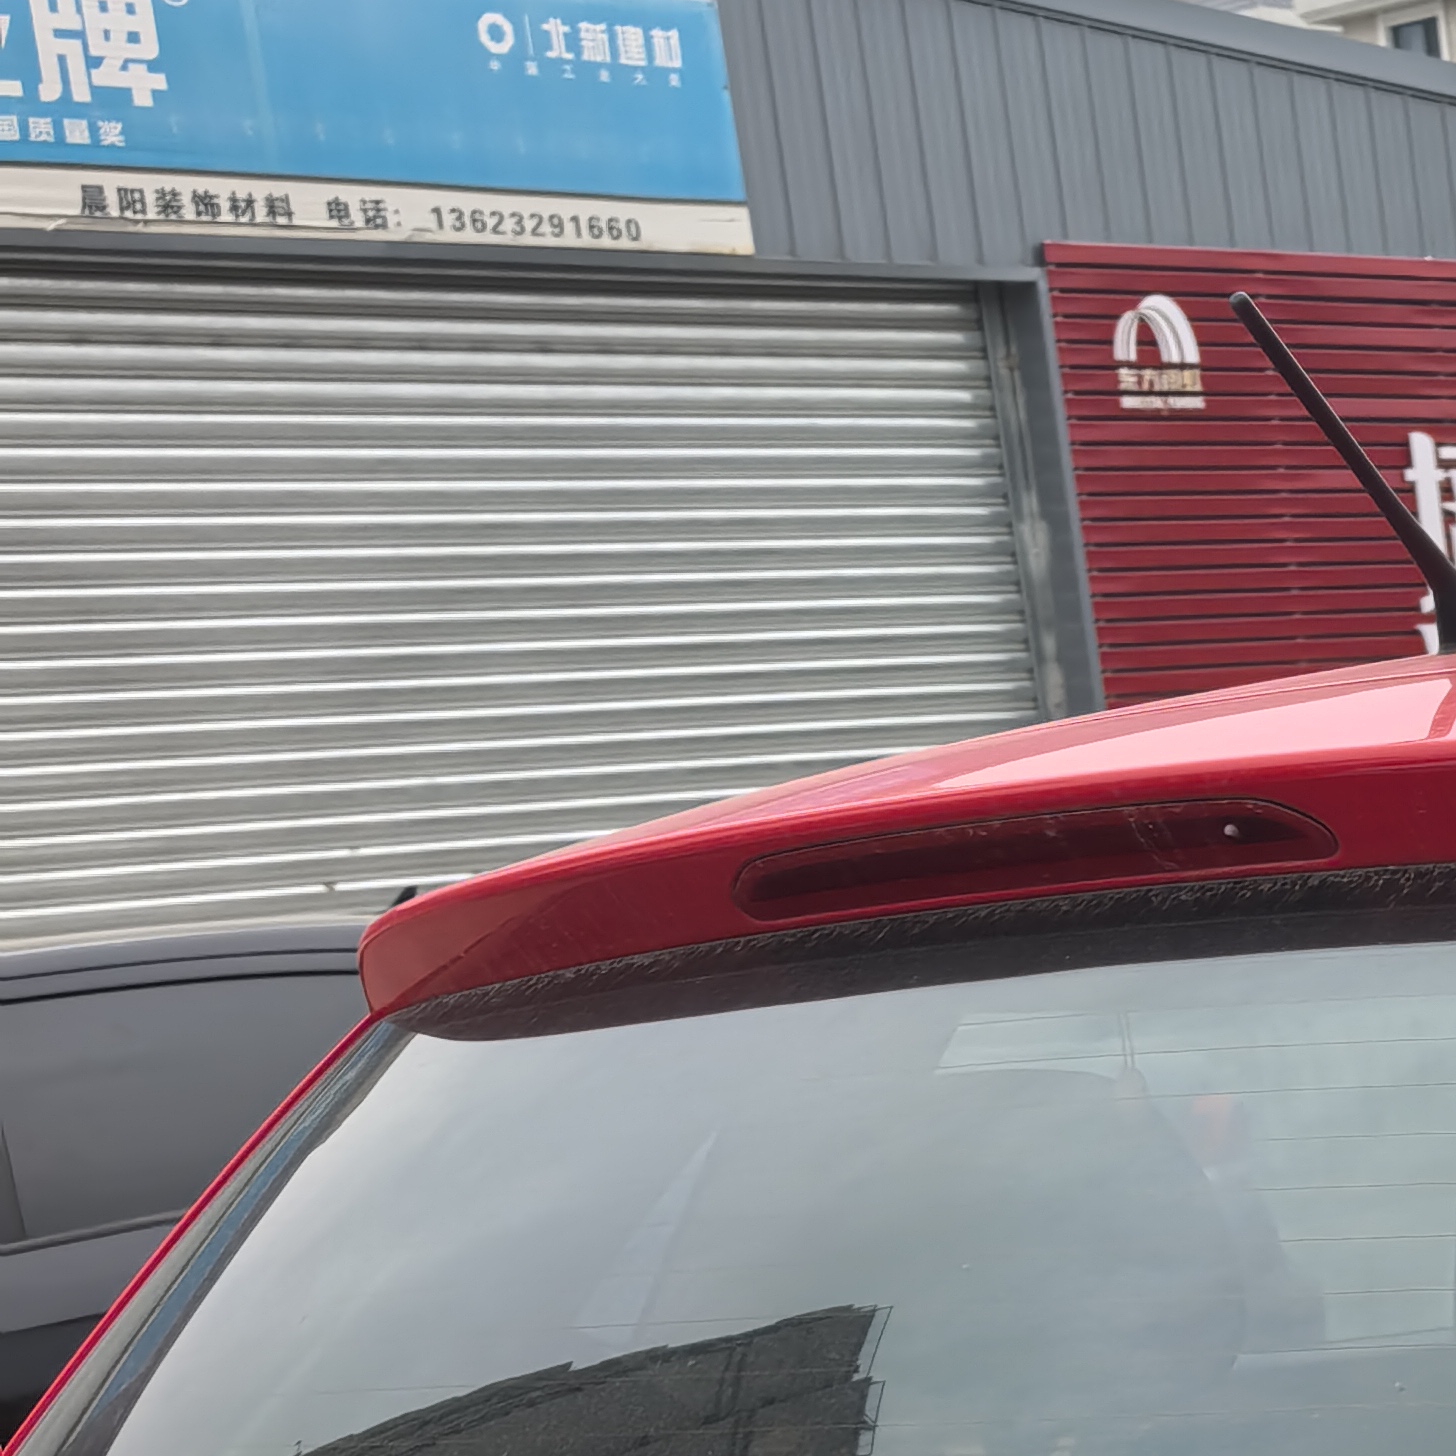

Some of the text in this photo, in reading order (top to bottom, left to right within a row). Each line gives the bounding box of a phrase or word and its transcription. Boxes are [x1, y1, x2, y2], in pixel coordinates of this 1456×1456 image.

[80, 182, 296, 225] 晨阳装饰材料
[431, 205, 643, 242] 13623291660
